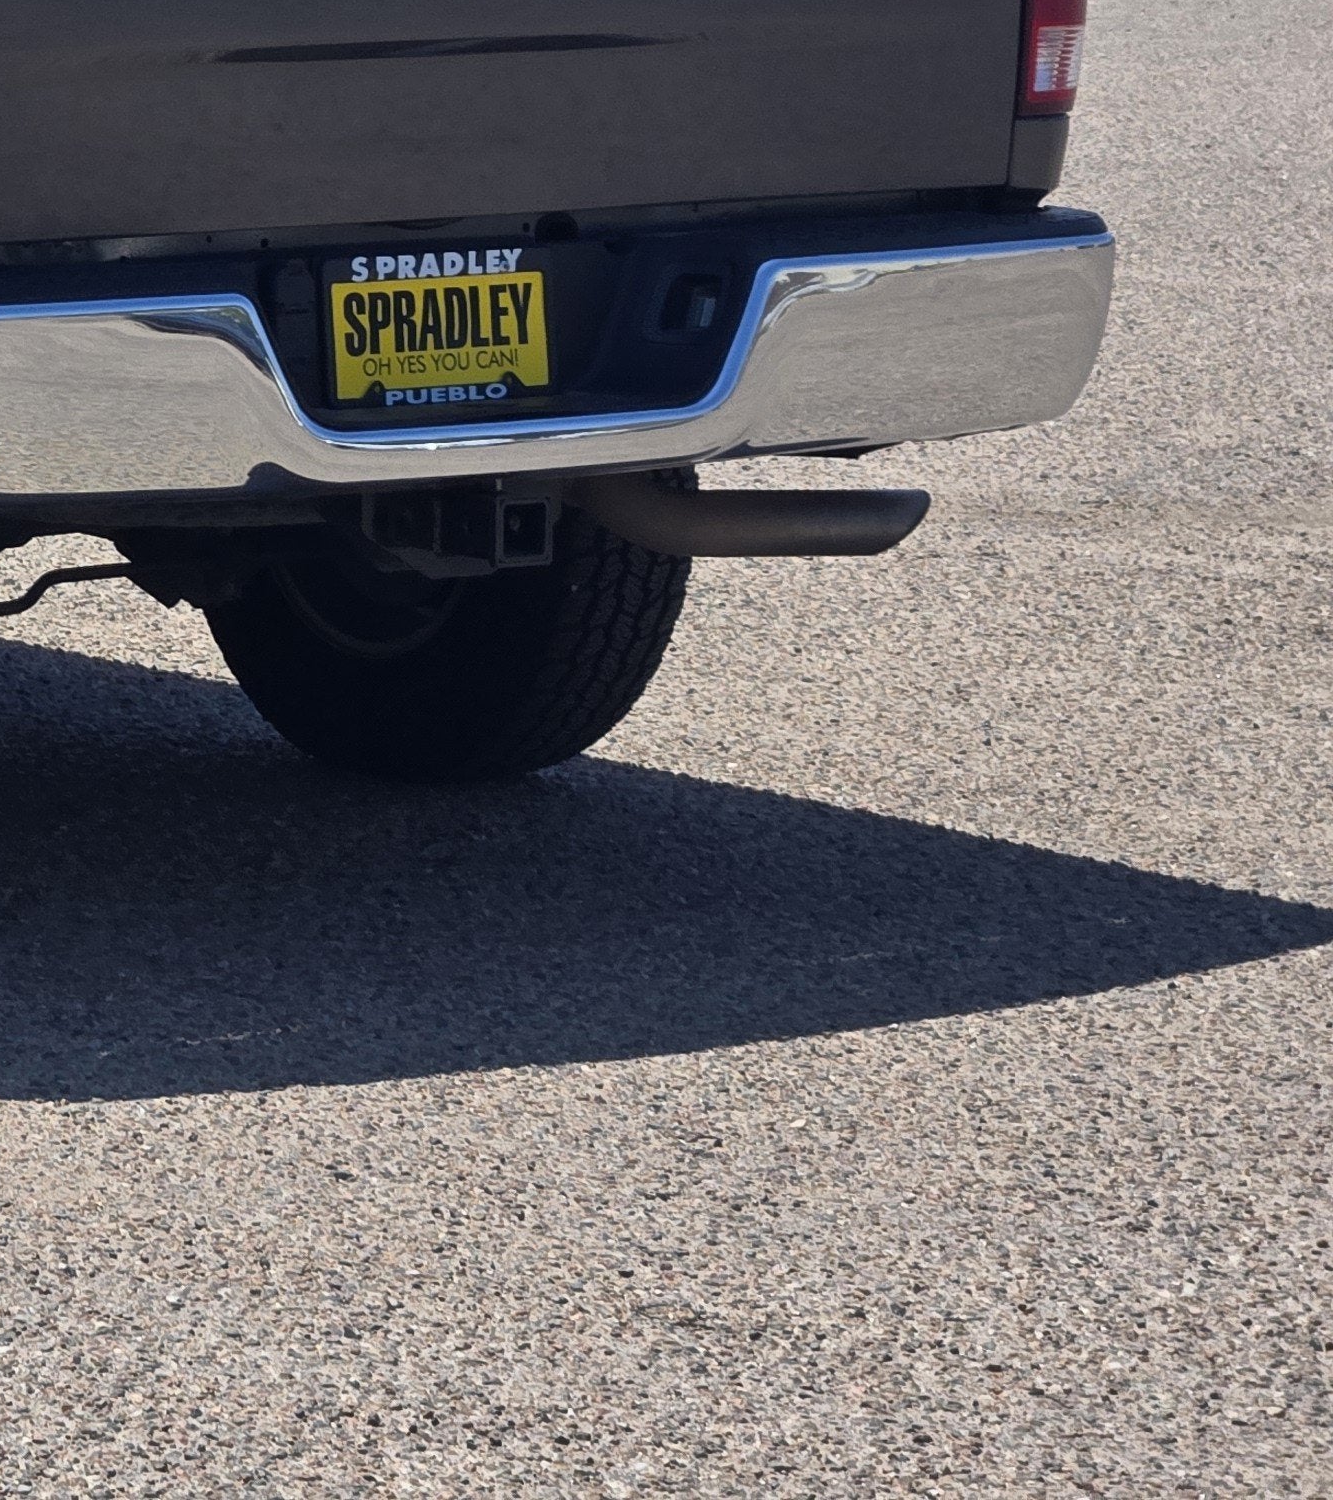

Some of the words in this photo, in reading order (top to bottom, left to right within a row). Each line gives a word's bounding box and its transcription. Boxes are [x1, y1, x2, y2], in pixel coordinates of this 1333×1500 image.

[351, 248, 522, 282] SPRADLEY
[343, 283, 532, 357] SPRADLEY
[363, 357, 391, 376] OH
[398, 355, 427, 374] YES
[431, 353, 470, 371] YOU
[476, 349, 519, 369] CAN!
[385, 383, 507, 406] PUEBLO
